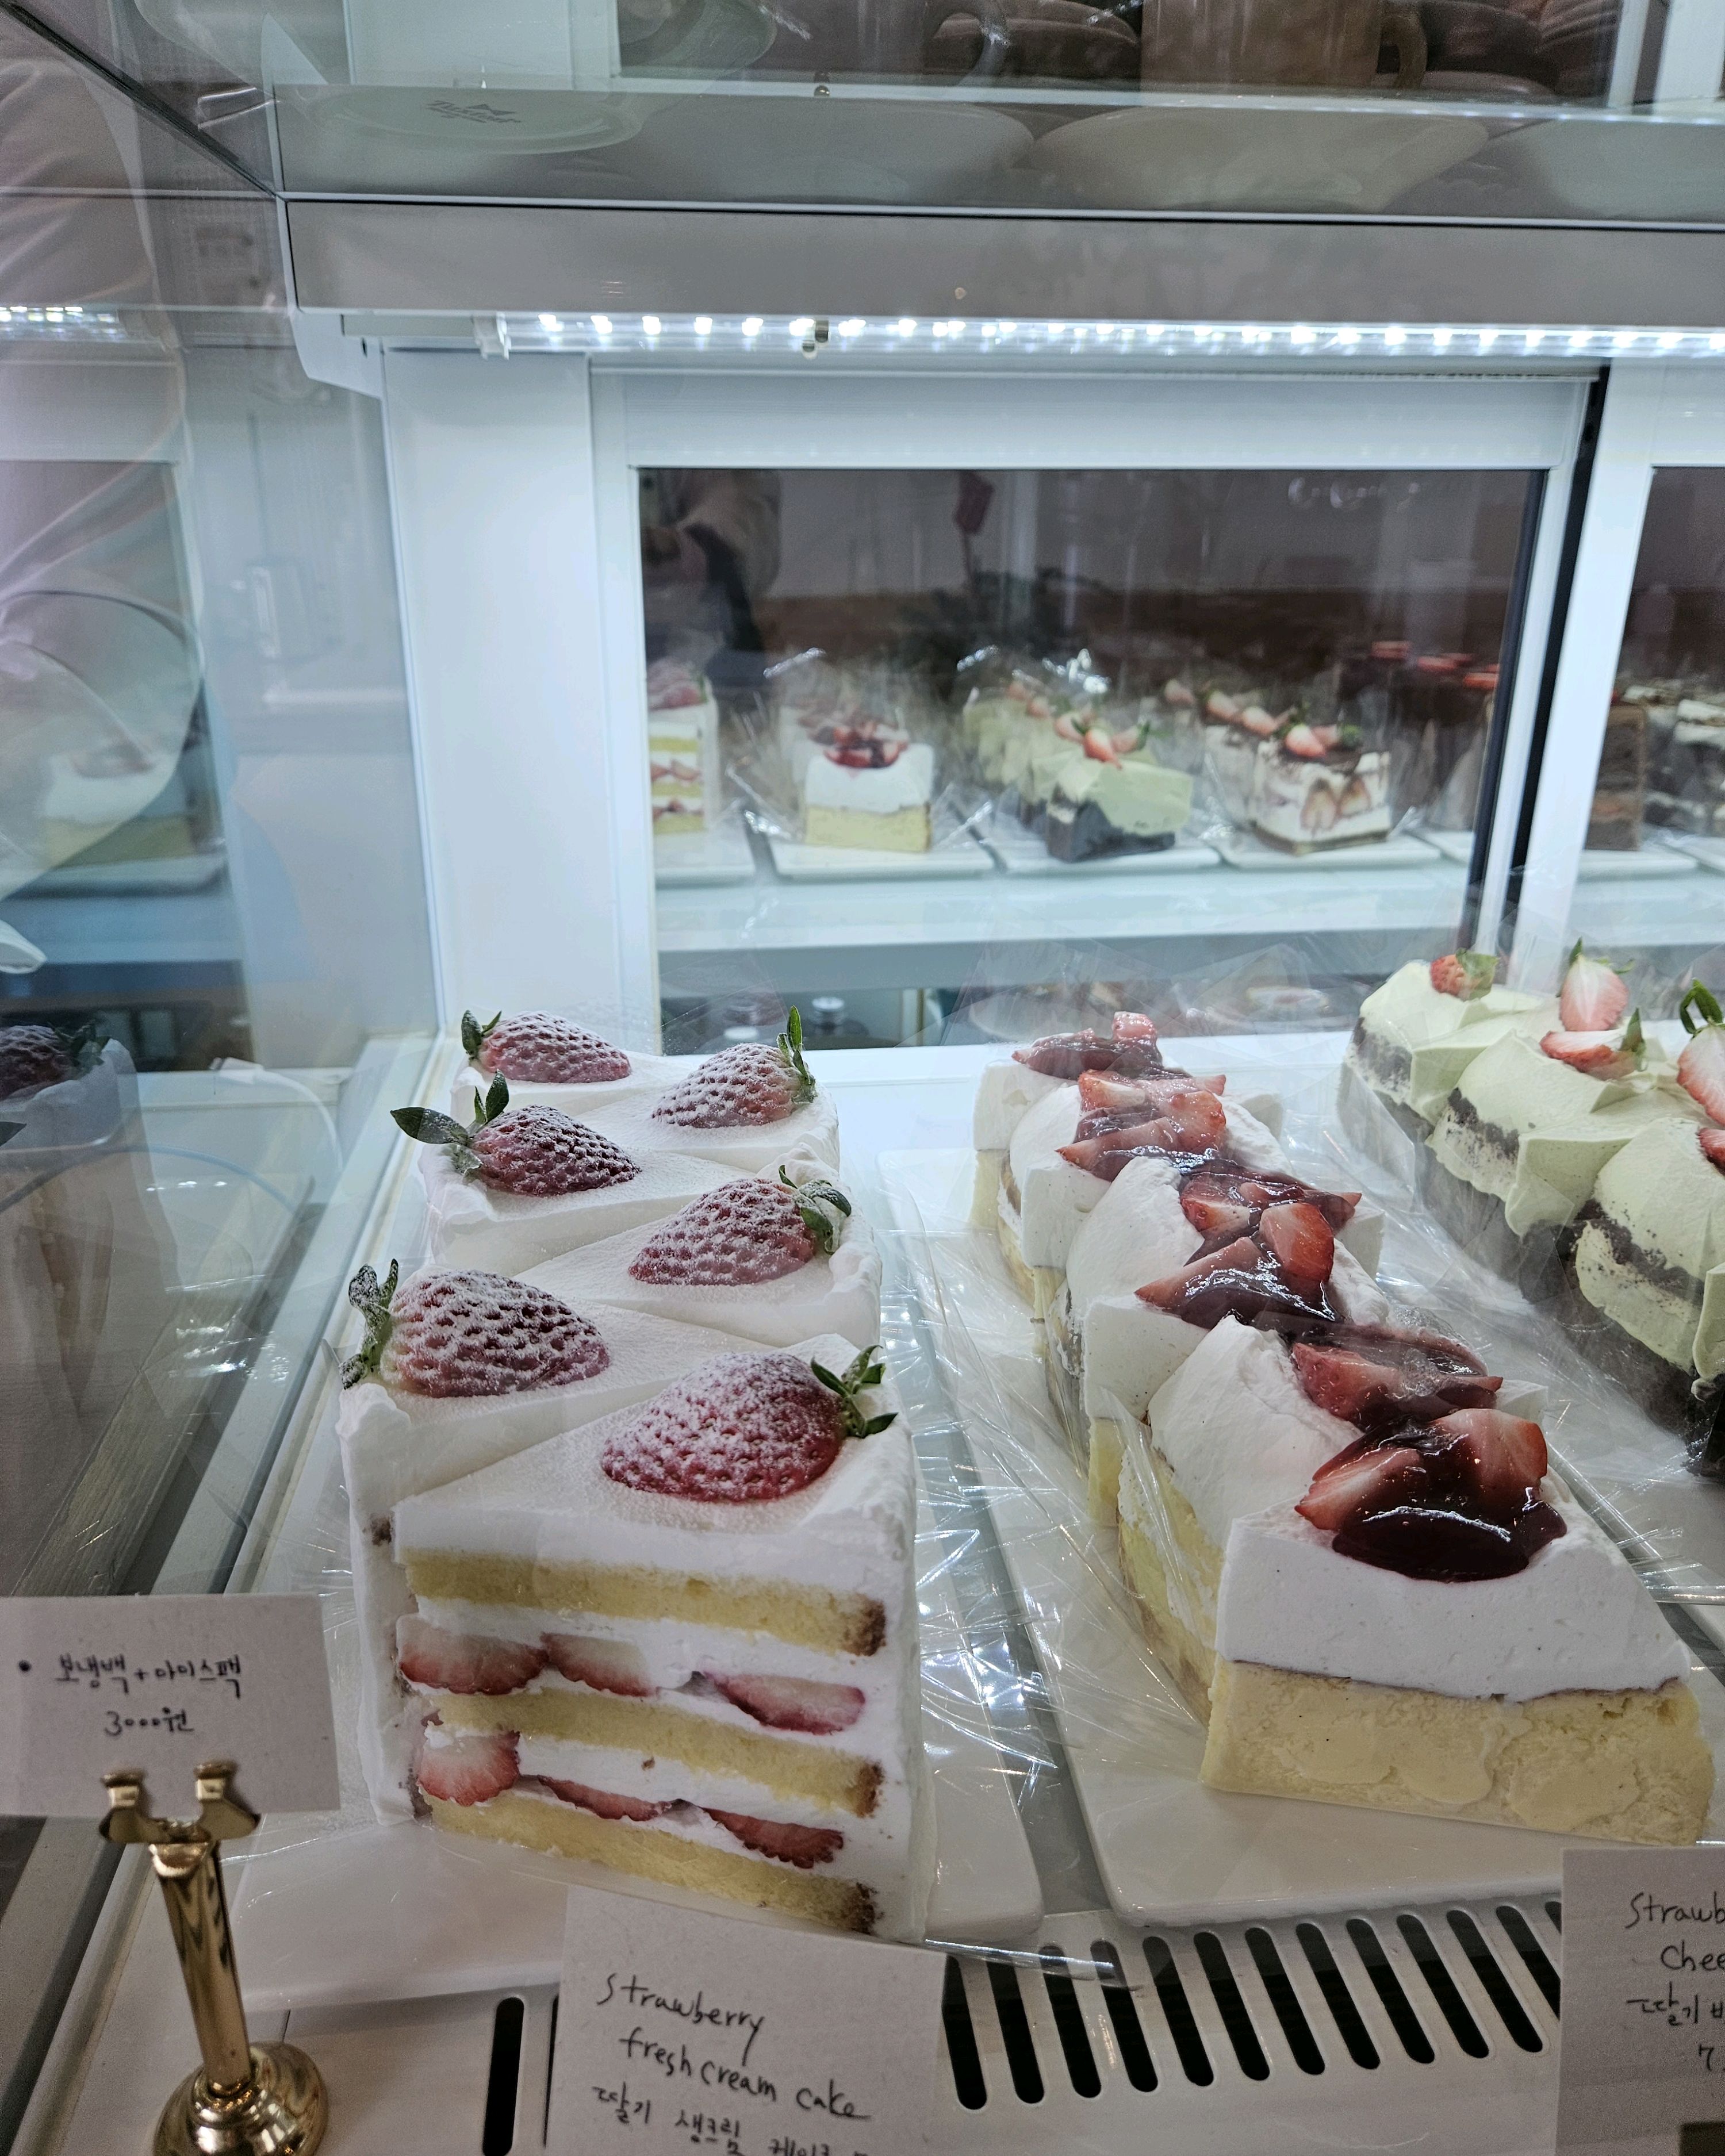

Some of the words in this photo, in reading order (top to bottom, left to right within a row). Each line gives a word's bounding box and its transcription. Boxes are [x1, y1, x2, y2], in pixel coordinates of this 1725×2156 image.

[104, 1706, 195, 1737] 3000원
[596, 1971, 765, 2066] Strawberry
[1626, 1981, 1699, 2027] 딸기
[592, 2081, 651, 2124] 딸기
